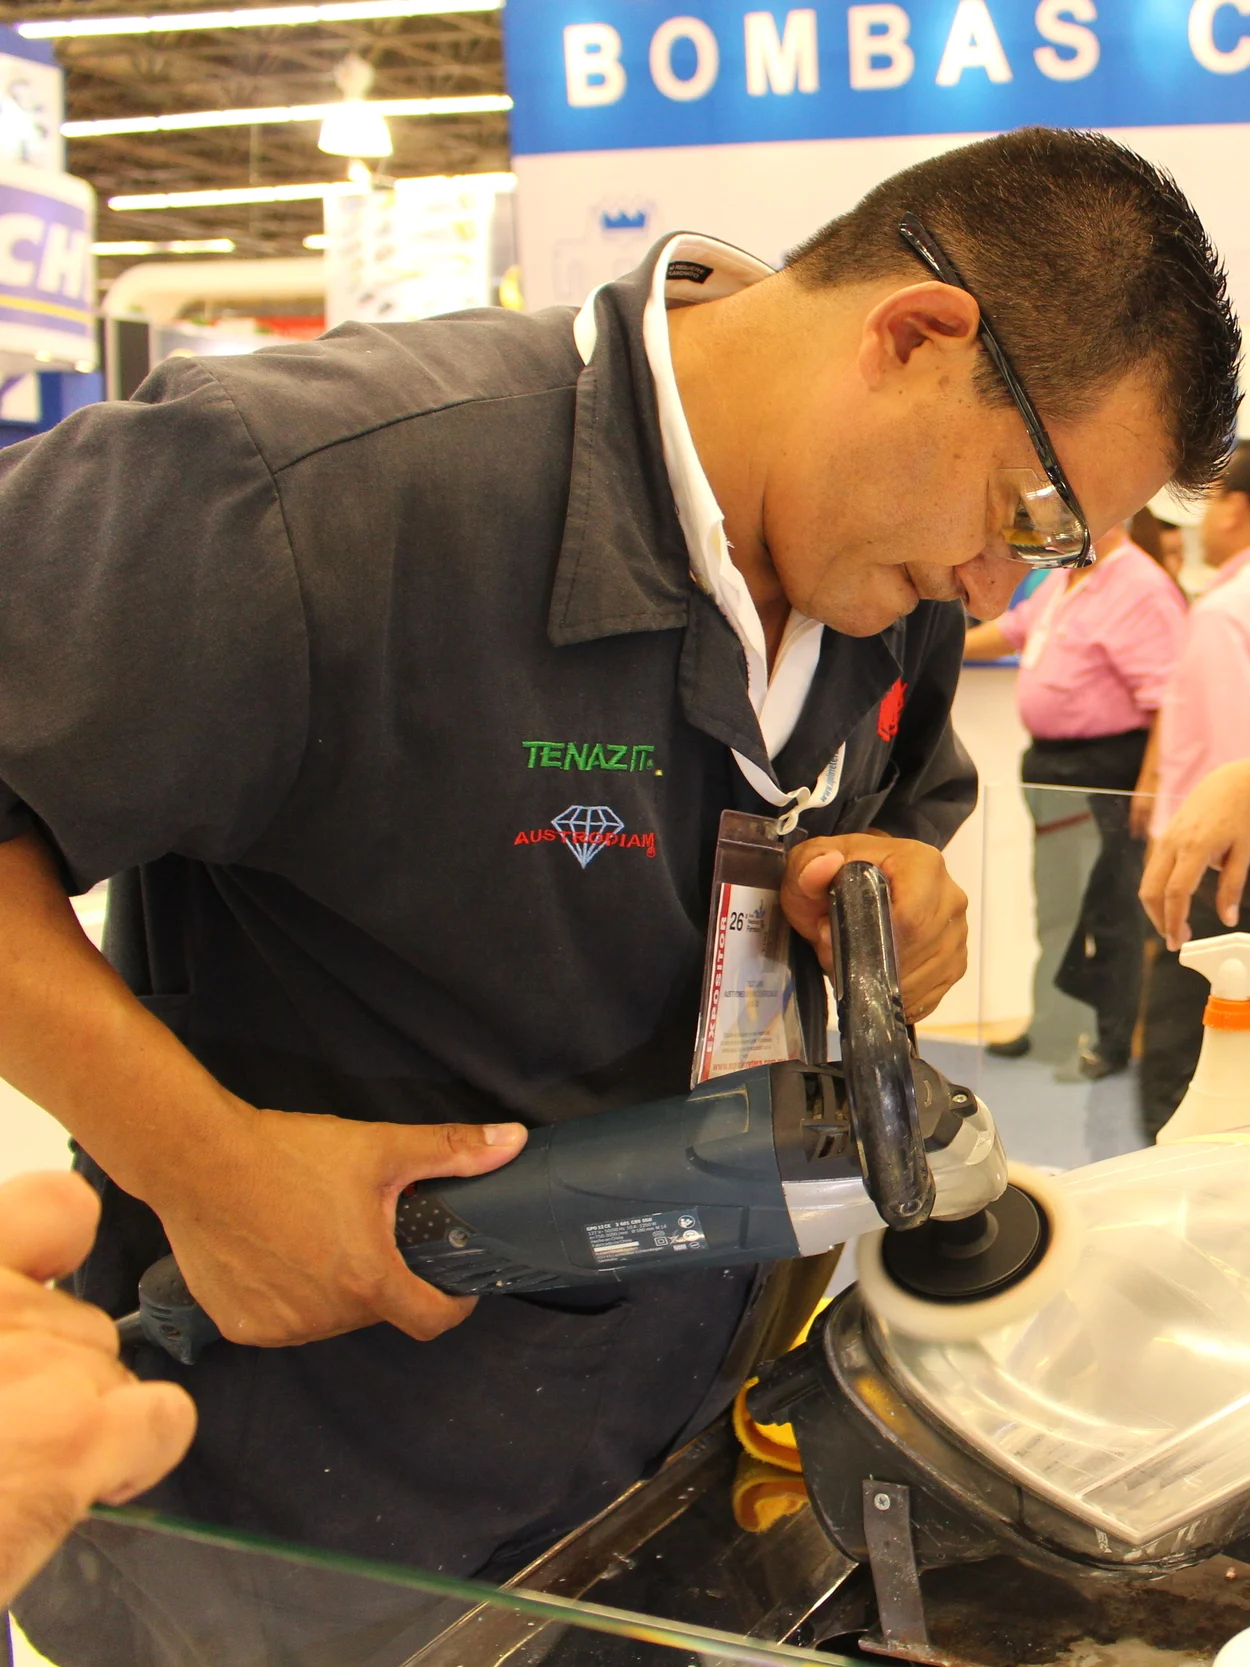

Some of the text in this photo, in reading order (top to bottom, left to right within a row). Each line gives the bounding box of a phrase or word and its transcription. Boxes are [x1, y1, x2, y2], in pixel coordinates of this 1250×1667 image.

[563, 0, 1099, 107] BOMBAS
[729, 911, 744, 932] 26
[706, 916, 727, 1053] EXPOSITOR
